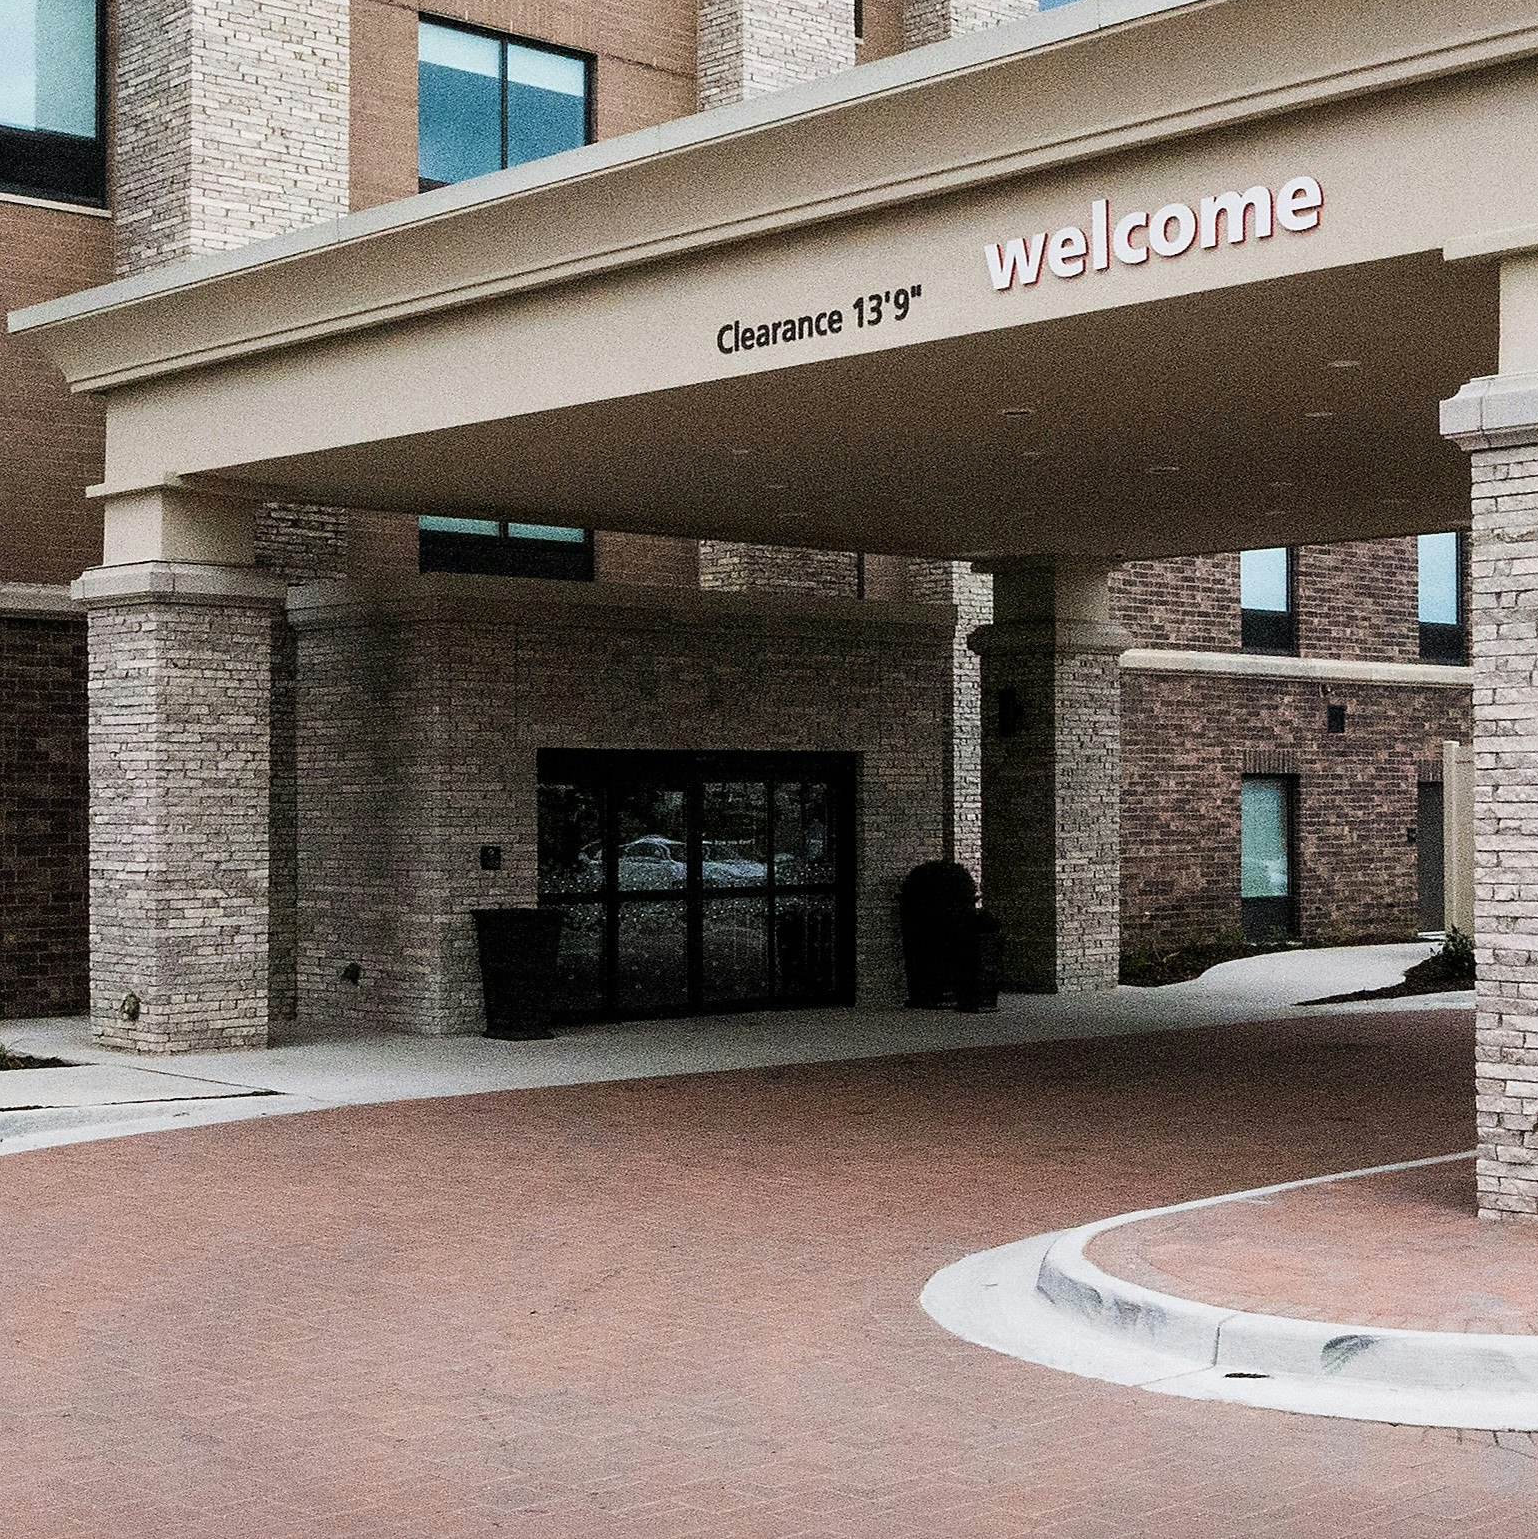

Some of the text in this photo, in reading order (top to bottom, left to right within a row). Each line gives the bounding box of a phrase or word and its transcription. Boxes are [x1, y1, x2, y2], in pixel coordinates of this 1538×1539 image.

[984, 175, 1324, 291] welcome
[717, 284, 922, 355] Clearance 13'9"
